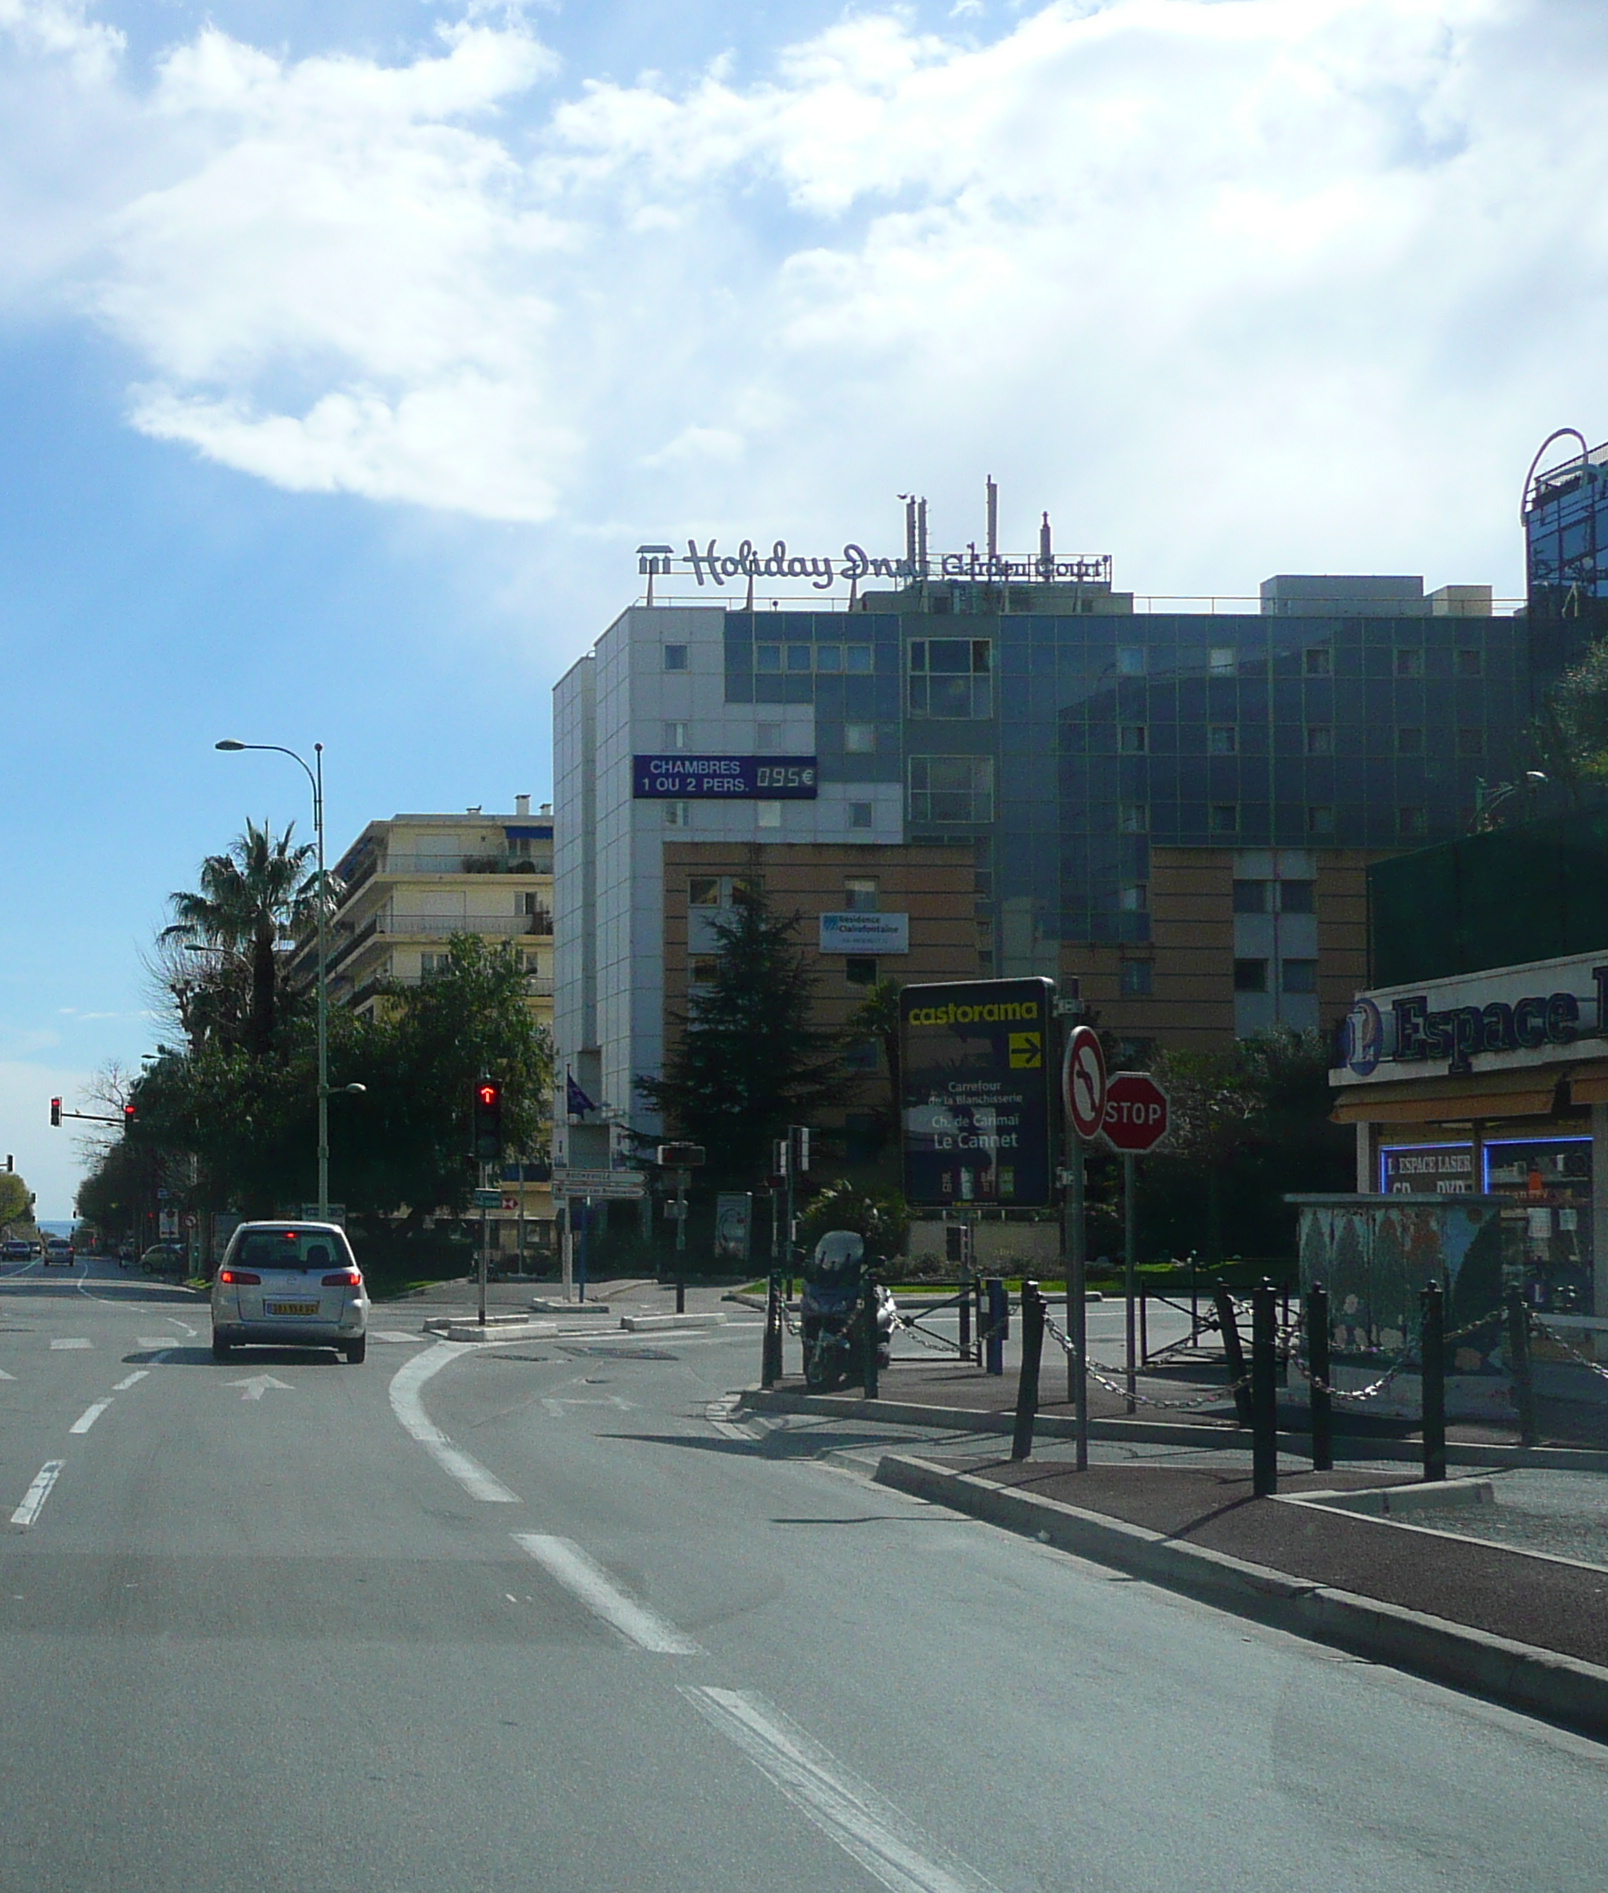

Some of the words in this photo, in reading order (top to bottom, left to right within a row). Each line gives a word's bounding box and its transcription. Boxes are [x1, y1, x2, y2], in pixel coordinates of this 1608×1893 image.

[682, 539, 833, 589] Holiday
[842, 544, 927, 580] Inn
[943, 553, 1027, 576] Garden
[1036, 556, 1102, 576] Court
[650, 760, 741, 774] CHAMBRES
[642, 779, 649, 791] 1
[656, 778, 679, 791] OU
[686, 778, 696, 791] 2
[703, 778, 749, 791] PERS.
[908, 1001, 1038, 1026] castorama
[1392, 992, 1580, 1075] Espace
[948, 1080, 1002, 1093] Carrefour
[944, 1095, 954, 1105] la
[956, 1093, 1023, 1105] Blanchisserie
[932, 1116, 951, 1128] Ch.
[955, 1115, 970, 1127] de
[1105, 1101, 1161, 1125] STOP
[934, 1134, 952, 1149] Le
[958, 1131, 1018, 1149] Cannet
[1398, 1155, 1436, 1174] ESPACE
[1438, 1154, 1472, 1173] LASER
